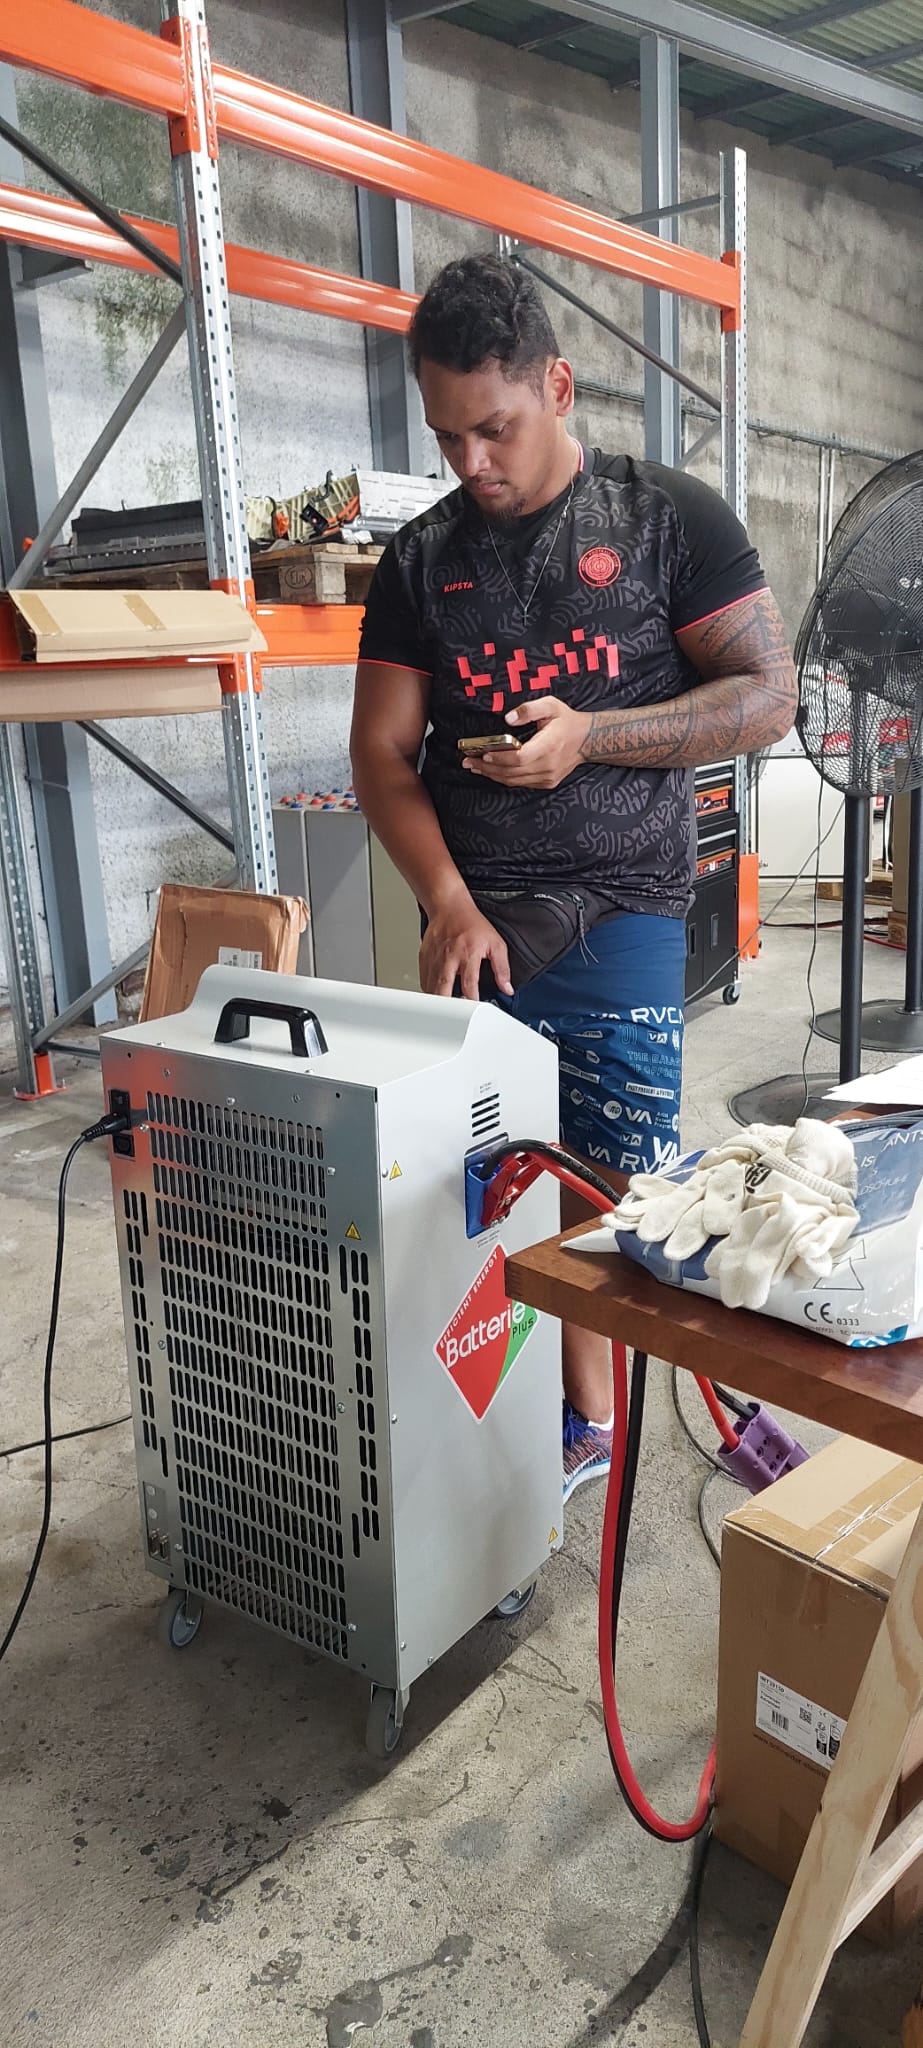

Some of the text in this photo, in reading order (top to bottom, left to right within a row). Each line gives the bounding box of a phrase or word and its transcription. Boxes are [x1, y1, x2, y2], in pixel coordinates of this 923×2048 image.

[444, 581, 473, 593] KIPSTA
[627, 1051, 649, 1062] THE
[625, 1106, 653, 1125] VA
[587, 1142, 611, 1163] VA
[439, 1295, 473, 1349] EFFICIENT
[472, 1251, 498, 1294] ENERGY
[803, 1301, 860, 1327] CE 0333
[446, 1301, 526, 1368] Batterie
